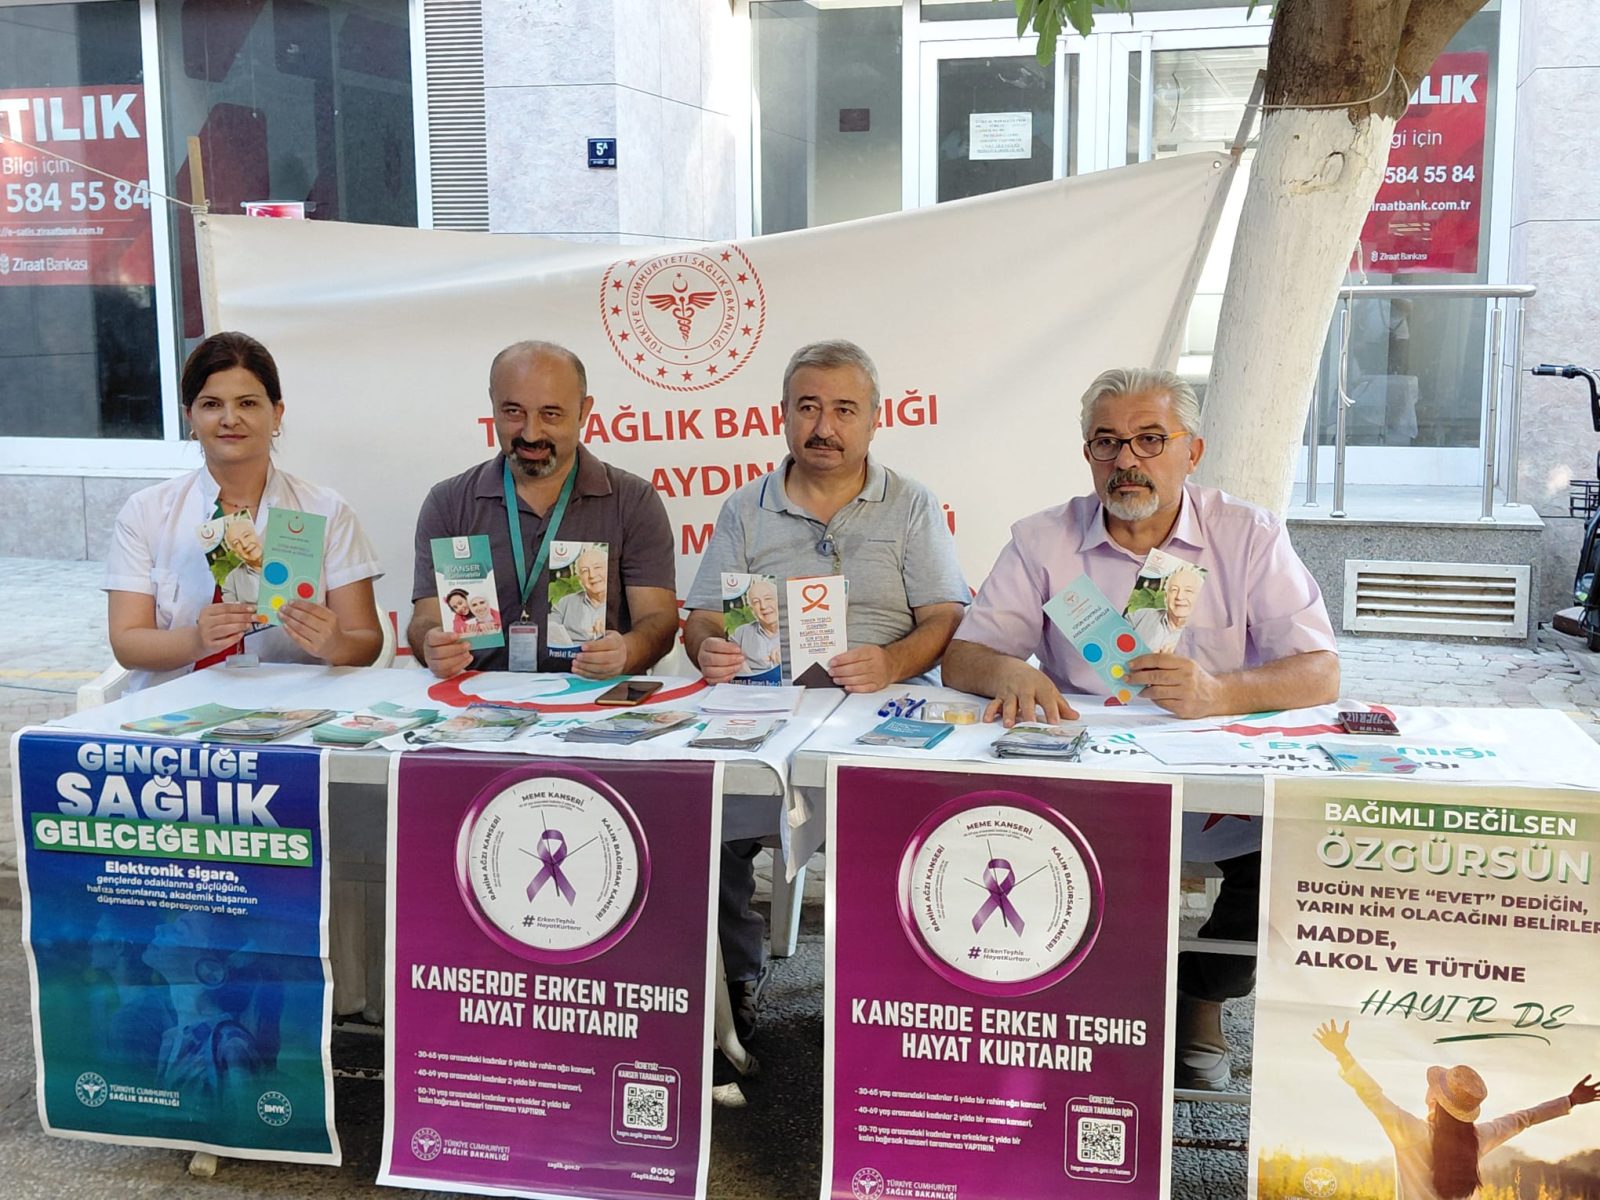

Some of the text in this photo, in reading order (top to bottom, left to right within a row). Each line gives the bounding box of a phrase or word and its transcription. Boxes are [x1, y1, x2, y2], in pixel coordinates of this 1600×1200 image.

[1409, 74, 1479, 105] LIK
[0, 93, 140, 143] TILIK
[1412, 129, 1443, 149] için
[2, 158, 38, 177] Bilgi
[1384, 165, 1475, 184] 584 55 84
[6, 180, 150, 213] 584 55 84
[1368, 200, 1471, 212] iraatbank.com.tr
[12, 257, 88, 272] Ziraat Bankası
[631, 254, 736, 354] TÜRKİYE CUMHURİYETİ SAĞLIK BAKANLIĞI
[584, 389, 938, 444] AĞLIK BAKIĞI
[77, 742, 259, 781] GENÇLİĞE
[56, 771, 281, 828] SAĞLIK
[521, 791, 546, 802] MEME
[548, 791, 585, 807] KANSERİ
[482, 814, 502, 850] KANSERİ
[601, 817, 618, 842] KALIN
[966, 820, 992, 831] MEME
[994, 820, 1034, 837] KANSERİ
[1324, 801, 1577, 837] BAĞIMLI DEĞİLSEN
[35, 818, 309, 861] GELECEĞE NEFES
[105, 860, 239, 883] Elektronik sigara,
[480, 851, 488, 872] AĞZI
[613, 843, 624, 887] BAĞIRSAK
[926, 844, 946, 880] KANSERİ
[1050, 846, 1069, 871] KALIN
[1316, 827, 1592, 885] ÖZGÜRSÜN
[87, 884, 114, 894] hafıza
[169, 890, 214, 902] akademik
[216, 894, 258, 905] başarının
[96, 875, 247, 894] gençlerde odaklanma güçlüğüne,
[483, 873, 497, 901] RAHİM
[922, 881, 931, 902] AĞZI
[1064, 872, 1075, 917] BAĞIRSAK
[1297, 879, 1365, 897] BUGÜN
[1370, 885, 1420, 901] NEYE
[1501, 894, 1588, 916] DEDİĞİN,
[97, 895, 145, 906] düşmesine
[147, 899, 157, 907] ve
[159, 900, 210, 912] depresyona
[211, 904, 225, 914] yol
[595, 888, 618, 922] KANSERİ
[925, 904, 941, 932] RAHİM
[1296, 899, 1600, 934] YARIN KİM OLACAĞINI BELİRLER
[1044, 918, 1070, 953] KANSERİ
[1297, 924, 1397, 950] MADDE,
[1295, 950, 1526, 984] ALKOL VE TÜTÜNE
[411, 964, 689, 1014] KANSERDE ERKEN TEŞHİS
[460, 998, 639, 1039] HAYAT KURTARIR
[851, 998, 1147, 1047] KANSERDE ERKEN TEŞHİS
[1360, 988, 1576, 1030] HAYIR DE
[902, 1032, 1093, 1073] HAYAT KURTARIR
[109, 1092, 180, 1107] SAĞLIK BAKANLIĞI
[442, 1147, 509, 1161] SAĞLIK BAKANLIĞI
[444, 1139, 511, 1154] TÜRKİYE CUMHURİYETİ
[885, 1187, 957, 1200] SAĞLIK BAKANLIĞI
[886, 1179, 958, 1193] TÜRKİYE CUMHURİYETİ
